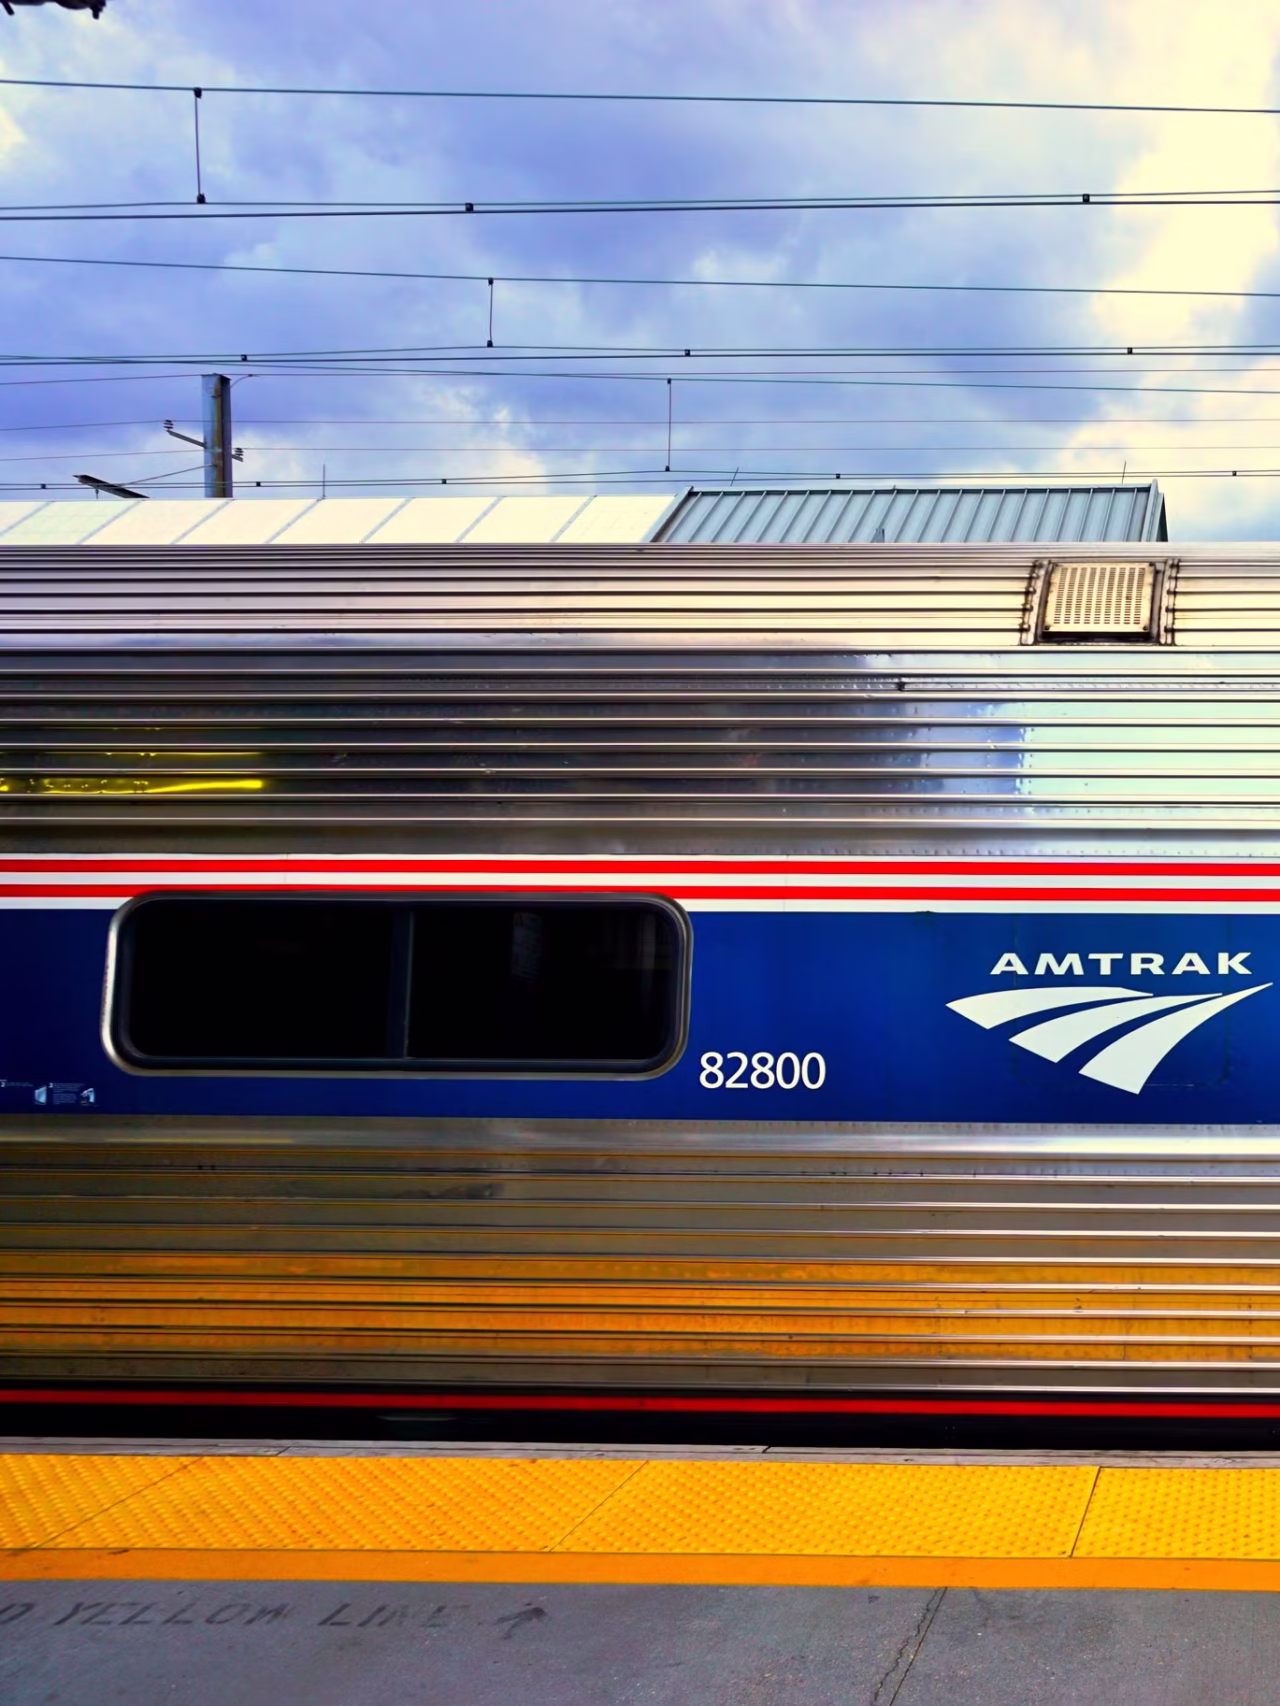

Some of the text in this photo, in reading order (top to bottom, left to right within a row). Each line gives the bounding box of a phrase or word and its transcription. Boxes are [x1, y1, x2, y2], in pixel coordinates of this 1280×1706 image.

[990, 952, 1252, 975] AMTRAK
[699, 1051, 827, 1090] 82800
[53, 1602, 291, 1625] YELLOW
